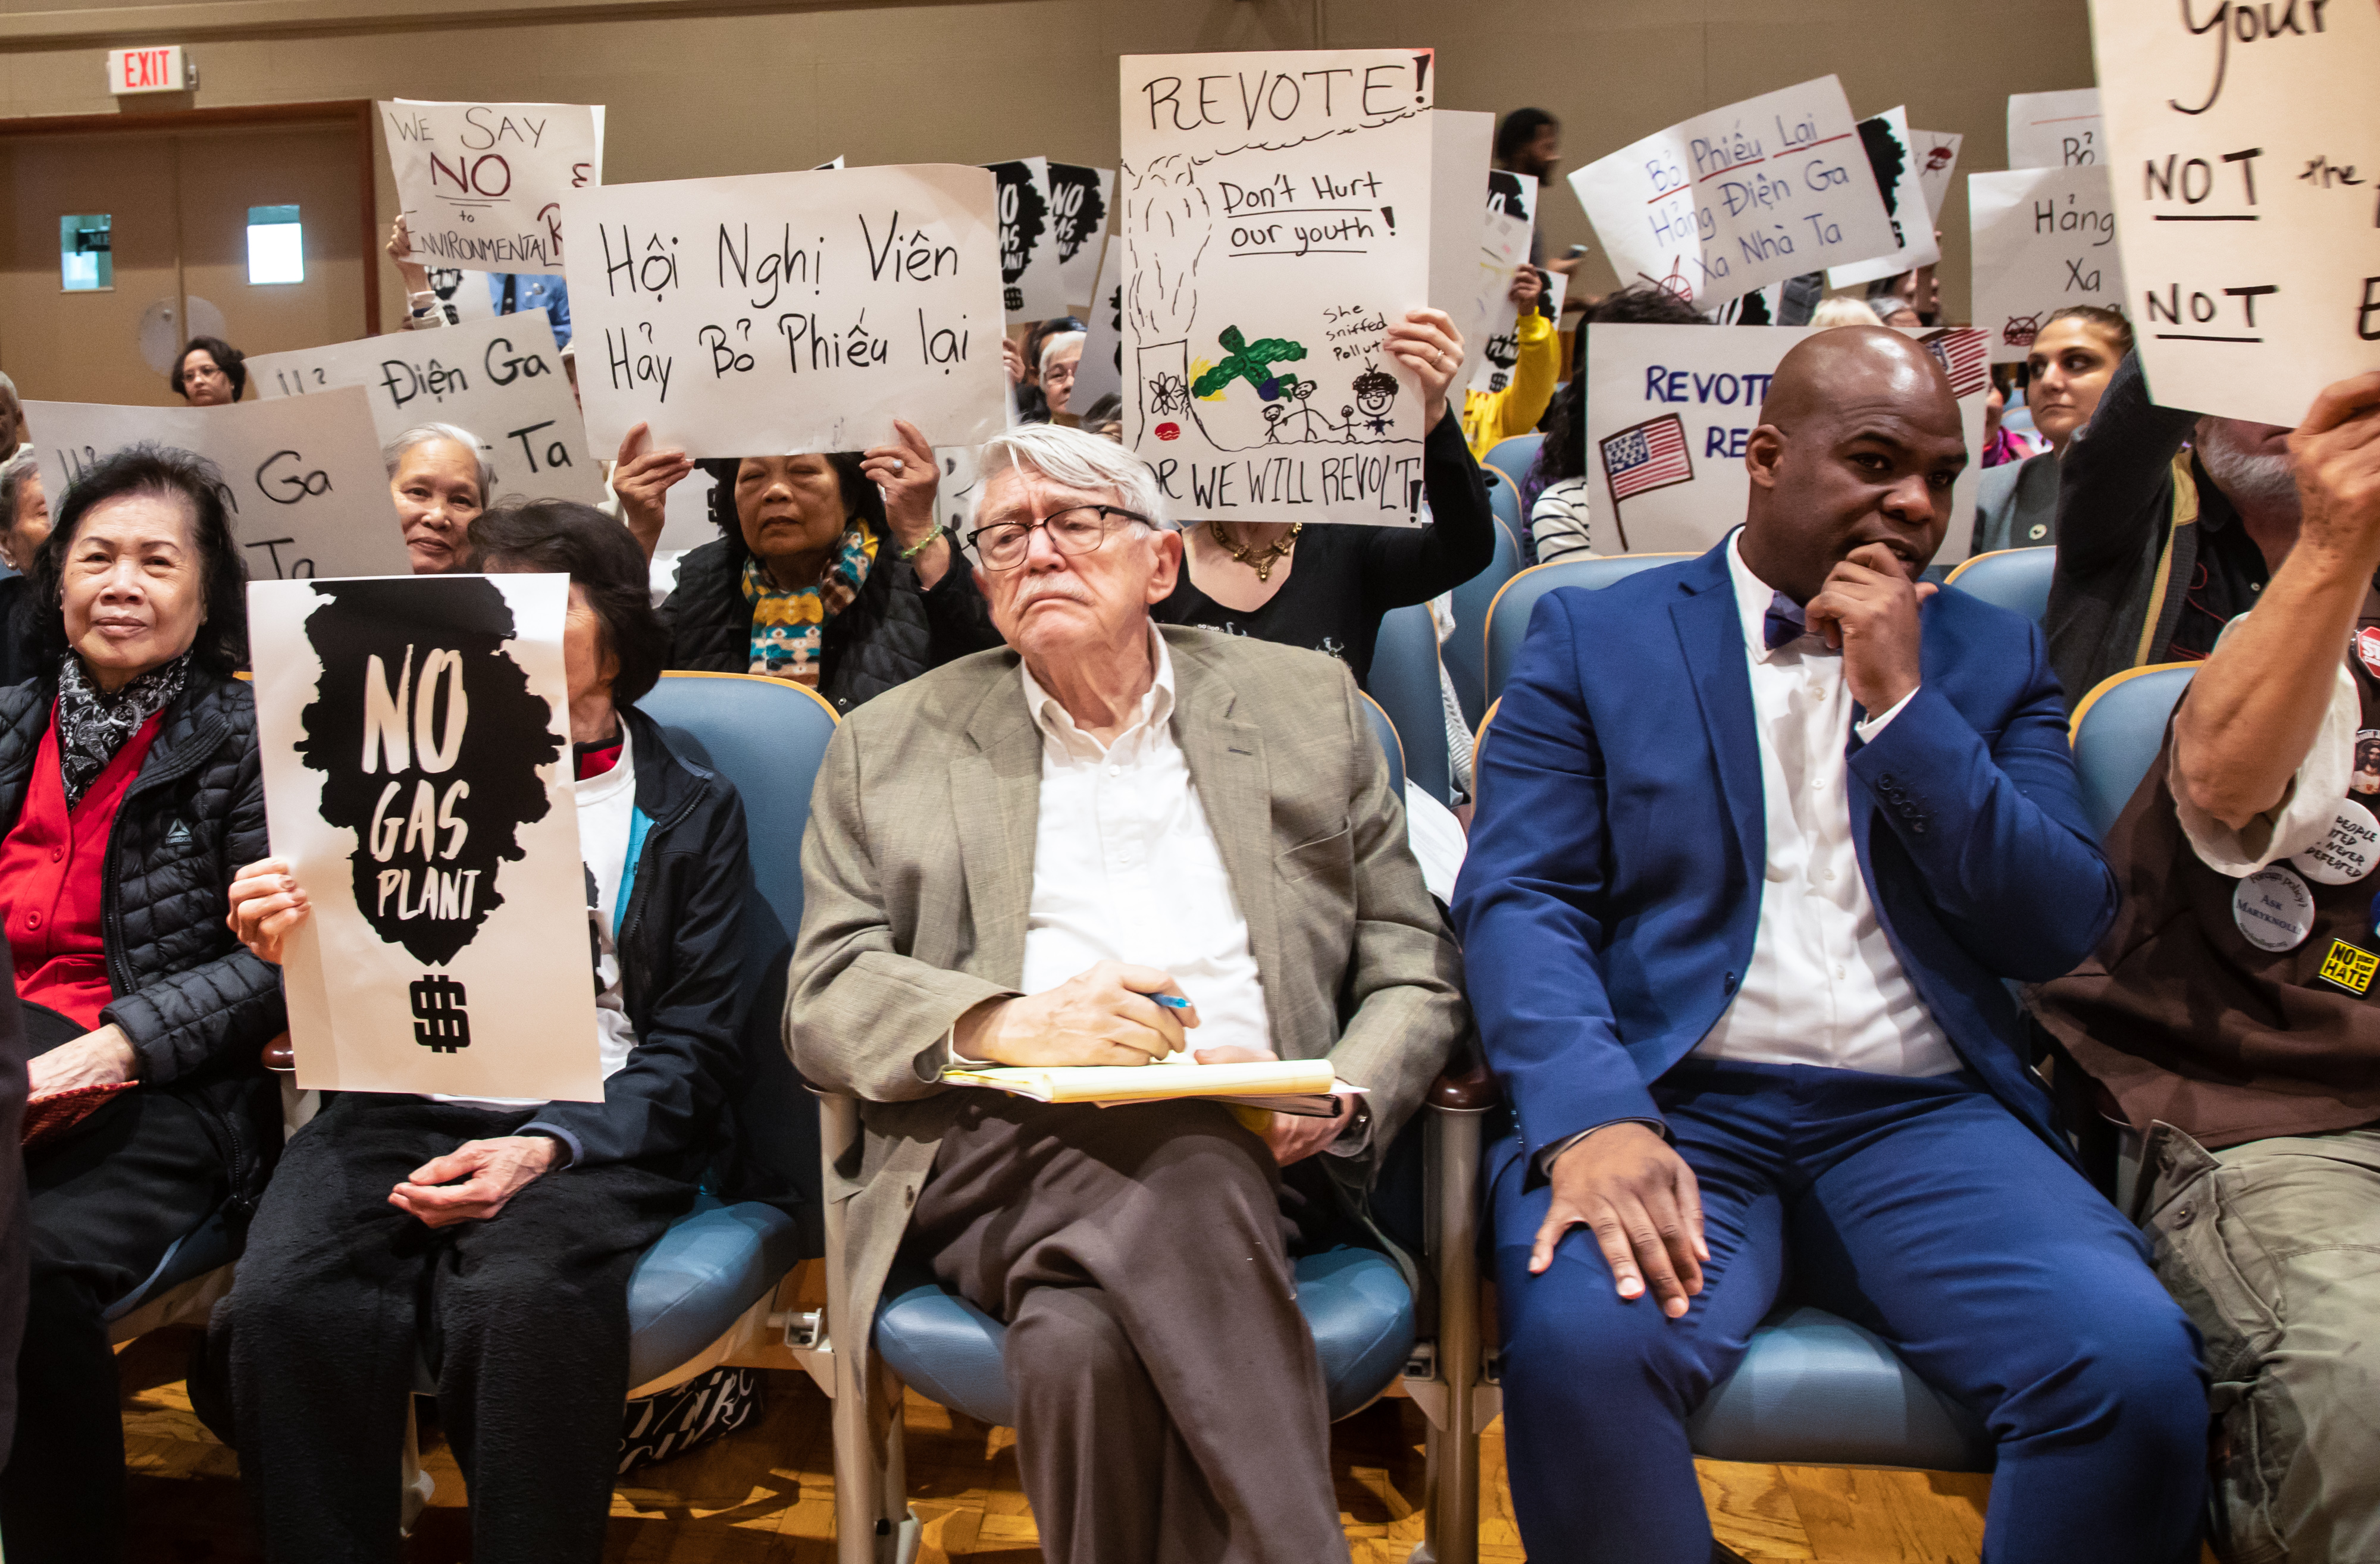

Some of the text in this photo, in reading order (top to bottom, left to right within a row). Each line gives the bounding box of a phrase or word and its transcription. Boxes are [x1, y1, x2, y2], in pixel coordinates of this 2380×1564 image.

[124, 50, 170, 87] EXIT
[1142, 54, 1431, 130] REVOTE!
[390, 106, 546, 150] WE SAY
[430, 152, 511, 197] NO
[1219, 171, 1383, 214] Don't Hurt
[1804, 159, 1849, 192] Ga
[2143, 147, 2265, 205] NOT
[459, 209, 475, 222] to
[1051, 181, 1085, 218] NO
[405, 210, 563, 267] ENVIRONMENTAL
[1000, 224, 1020, 253] AS
[1054, 217, 1078, 241] AS
[1230, 206, 1396, 256] our youth!
[1693, 212, 1843, 287] Xa Nhà Ta
[599, 209, 958, 308] Hội Nghị Viên
[2065, 257, 2101, 292] Xa
[1323, 305, 1364, 324] She
[1326, 312, 1388, 341] sniffed
[2147, 283, 2282, 328] NOT
[699, 318, 754, 379] Bỏ
[778, 308, 888, 374] Phiếu
[1333, 338, 1384, 362] Pollut
[380, 358, 469, 409] Điện
[485, 337, 552, 386] Ga
[508, 419, 573, 474] Ta
[255, 450, 333, 504] Ga
[1191, 462, 1238, 510] WE
[1248, 457, 1314, 504] WILL
[1322, 452, 1424, 524] REVOLT!
[362, 644, 469, 775] NO
[165, 836, 192, 844] Reebok
[369, 779, 469, 862] GAS
[2304, 847, 2363, 877] DEFEATED
[377, 866, 481, 920] PLANT
[2323, 960, 2369, 989] HATE
[2331, 944, 2356, 965] NO
